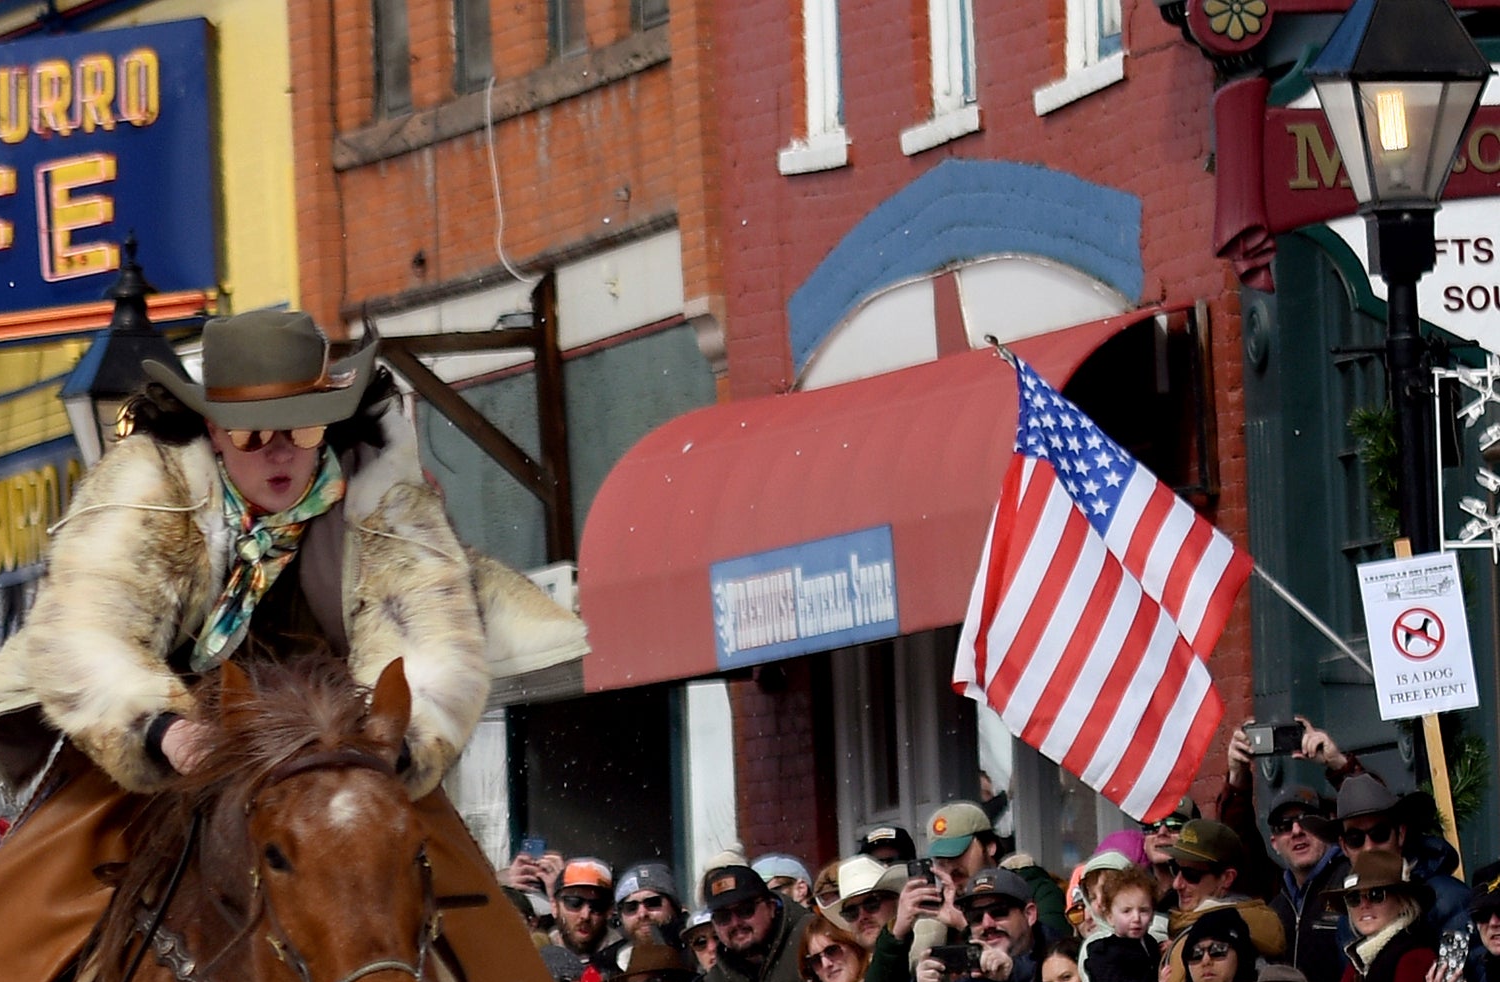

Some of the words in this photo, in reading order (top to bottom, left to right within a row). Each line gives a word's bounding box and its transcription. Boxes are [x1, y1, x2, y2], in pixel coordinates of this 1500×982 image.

[1396, 674, 1409, 686] IS
[1411, 672, 1421, 684] A
[1423, 667, 1454, 683] DOG
[1389, 689, 1423, 705] FREE
[1423, 682, 1468, 700] EVENT
